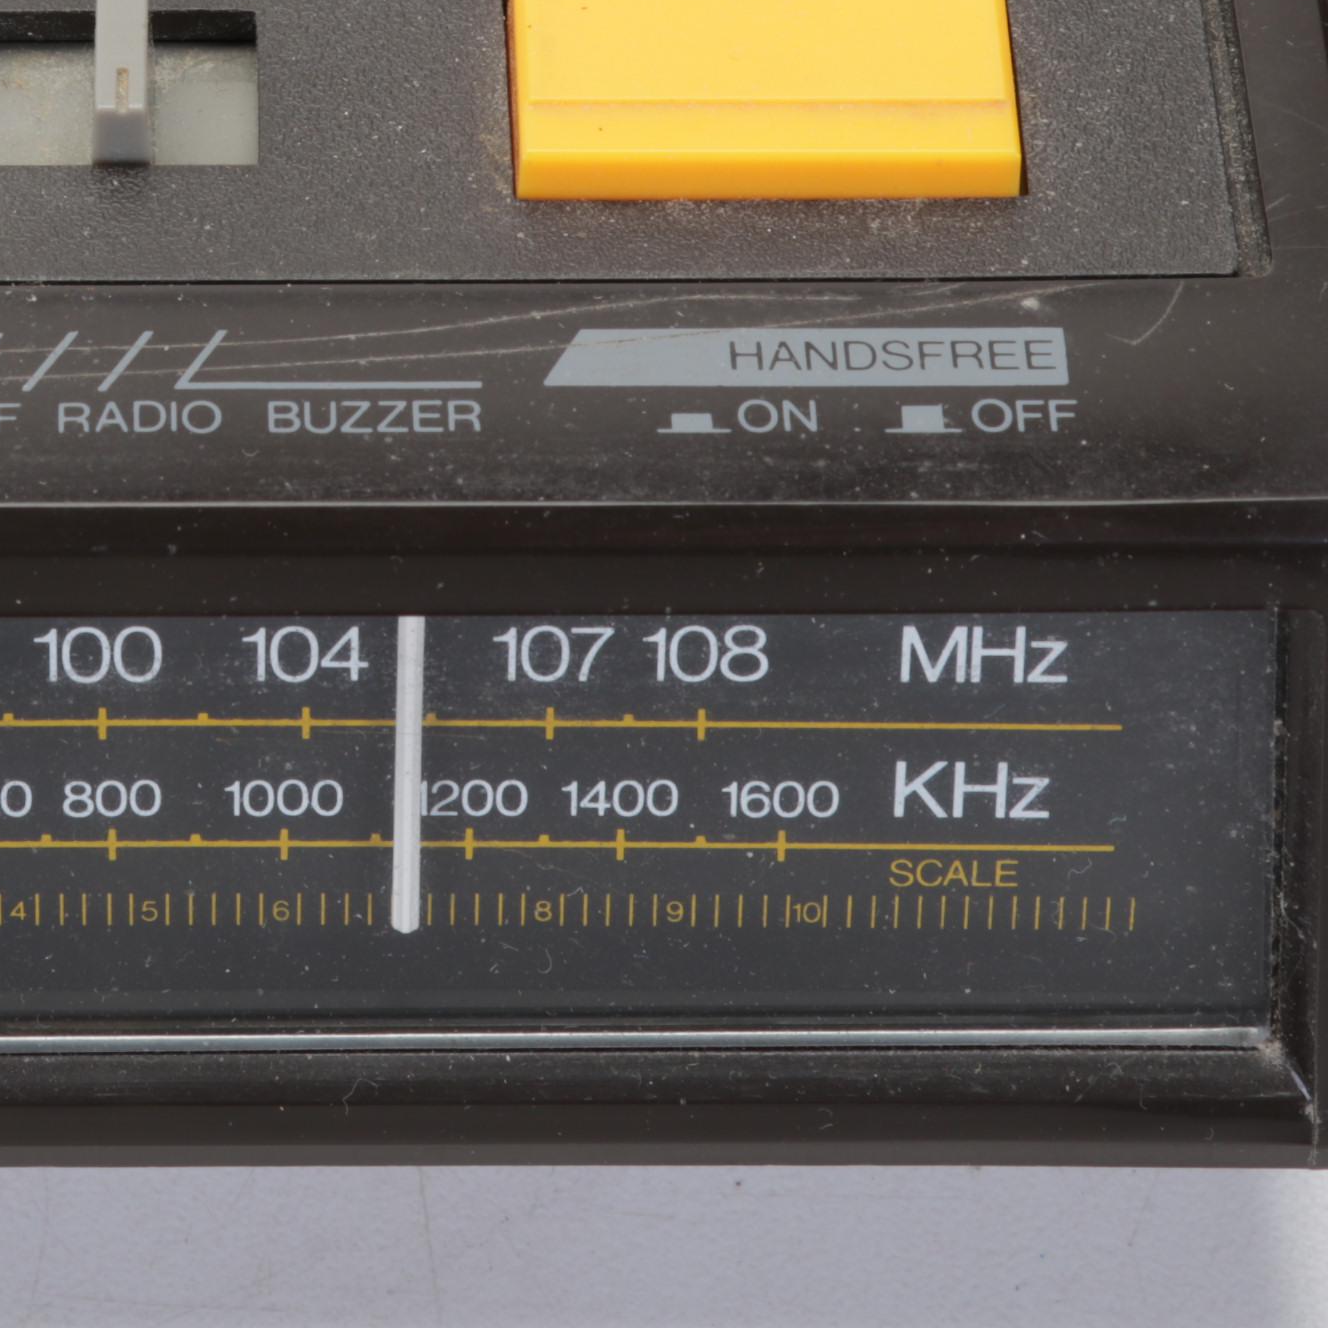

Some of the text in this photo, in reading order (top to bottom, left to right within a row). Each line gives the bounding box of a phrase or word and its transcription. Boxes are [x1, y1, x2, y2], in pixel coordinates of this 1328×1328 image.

[729, 339, 1057, 371] HANDSFREE
[57, 399, 222, 434] RADIO
[267, 399, 481, 434] BUZZER
[737, 398, 818, 433] ON
[971, 398, 1078, 433] OFF
[33, 625, 163, 684] 100
[241, 625, 369, 683] 104
[492, 624, 615, 683] 107
[642, 624, 769, 683] 108
[900, 625, 1068, 684] MHz
[62, 779, 162, 818] 800
[224, 778, 344, 817] 1000
[420, 778, 529, 817] 1200
[561, 779, 679, 818] 1400
[721, 780, 840, 819] 1600
[893, 760, 1050, 819] KHz
[890, 858, 1018, 888] SCALE
[9, 901, 28, 921] 4
[140, 900, 159, 922] 5
[271, 900, 291, 922] 6
[533, 900, 553, 923] 8
[665, 901, 685, 923] 9
[792, 902, 822, 924] 10
